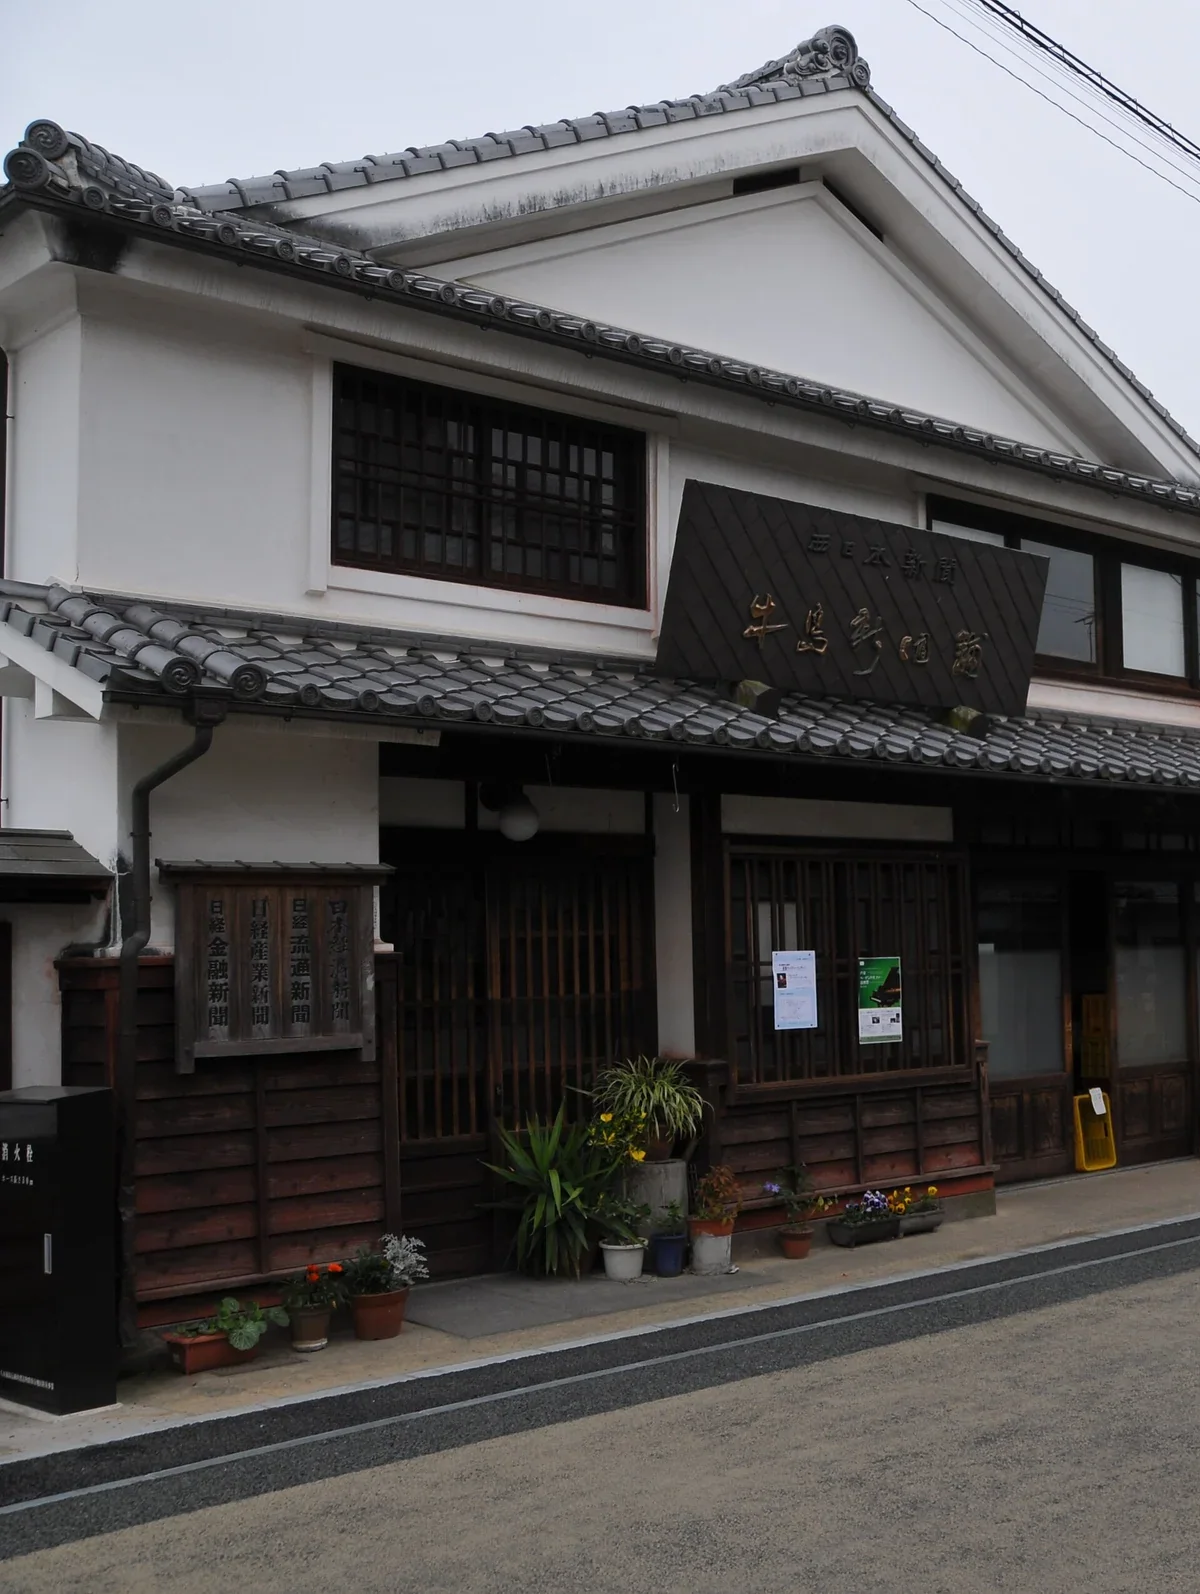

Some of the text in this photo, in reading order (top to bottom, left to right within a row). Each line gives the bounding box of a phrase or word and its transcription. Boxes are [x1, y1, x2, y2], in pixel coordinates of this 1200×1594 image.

[808, 533, 957, 585] 西日本新聞
[208, 900, 229, 1027] 日経金融新聞
[251, 898, 269, 1025] 日経産業新聞
[290, 899, 310, 1024] 日経流通新聞
[2, 1142, 33, 1162] 消火栓
